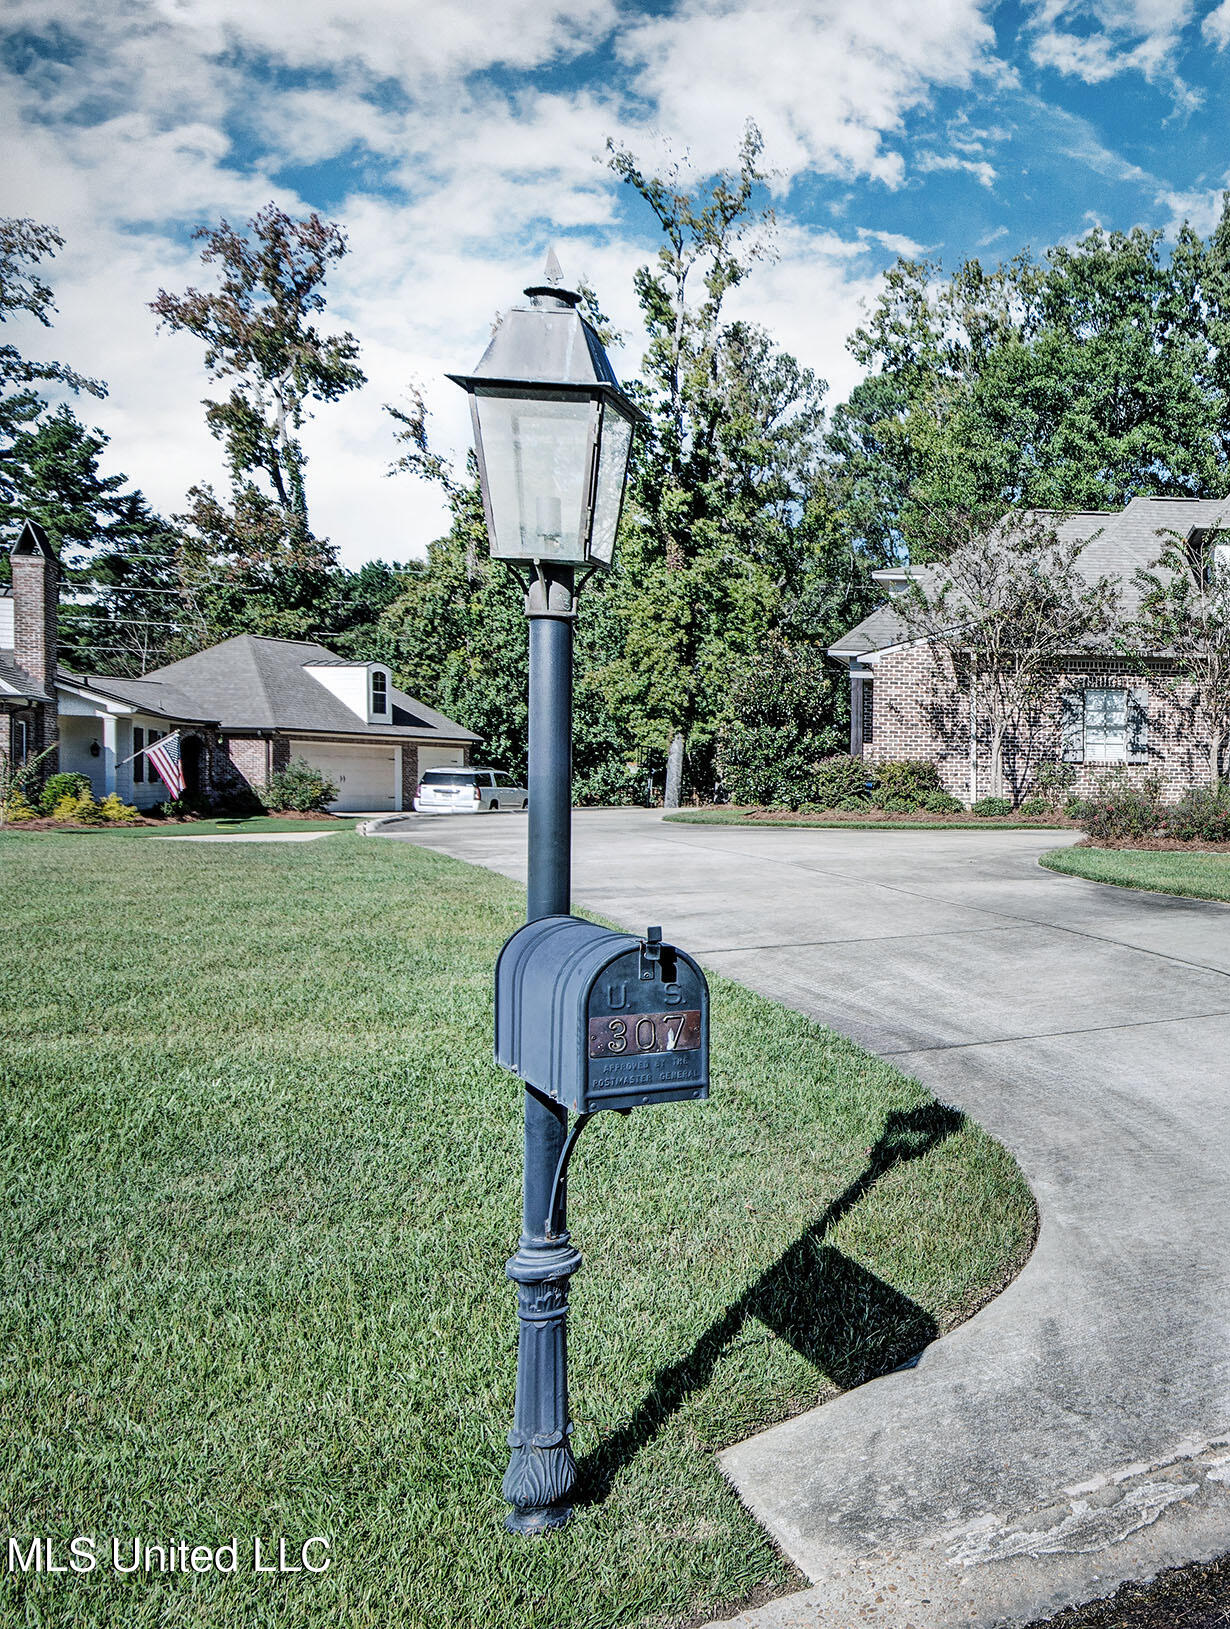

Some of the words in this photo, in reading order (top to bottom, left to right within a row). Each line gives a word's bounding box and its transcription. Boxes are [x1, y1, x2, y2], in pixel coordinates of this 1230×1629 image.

[608, 1014, 686, 1054] 307
[603, 1060, 649, 1075] APPROVED
[673, 1056, 689, 1067] THE
[593, 1073, 653, 1089] POSTMASTER
[659, 1070, 698, 1082] GENERAL
